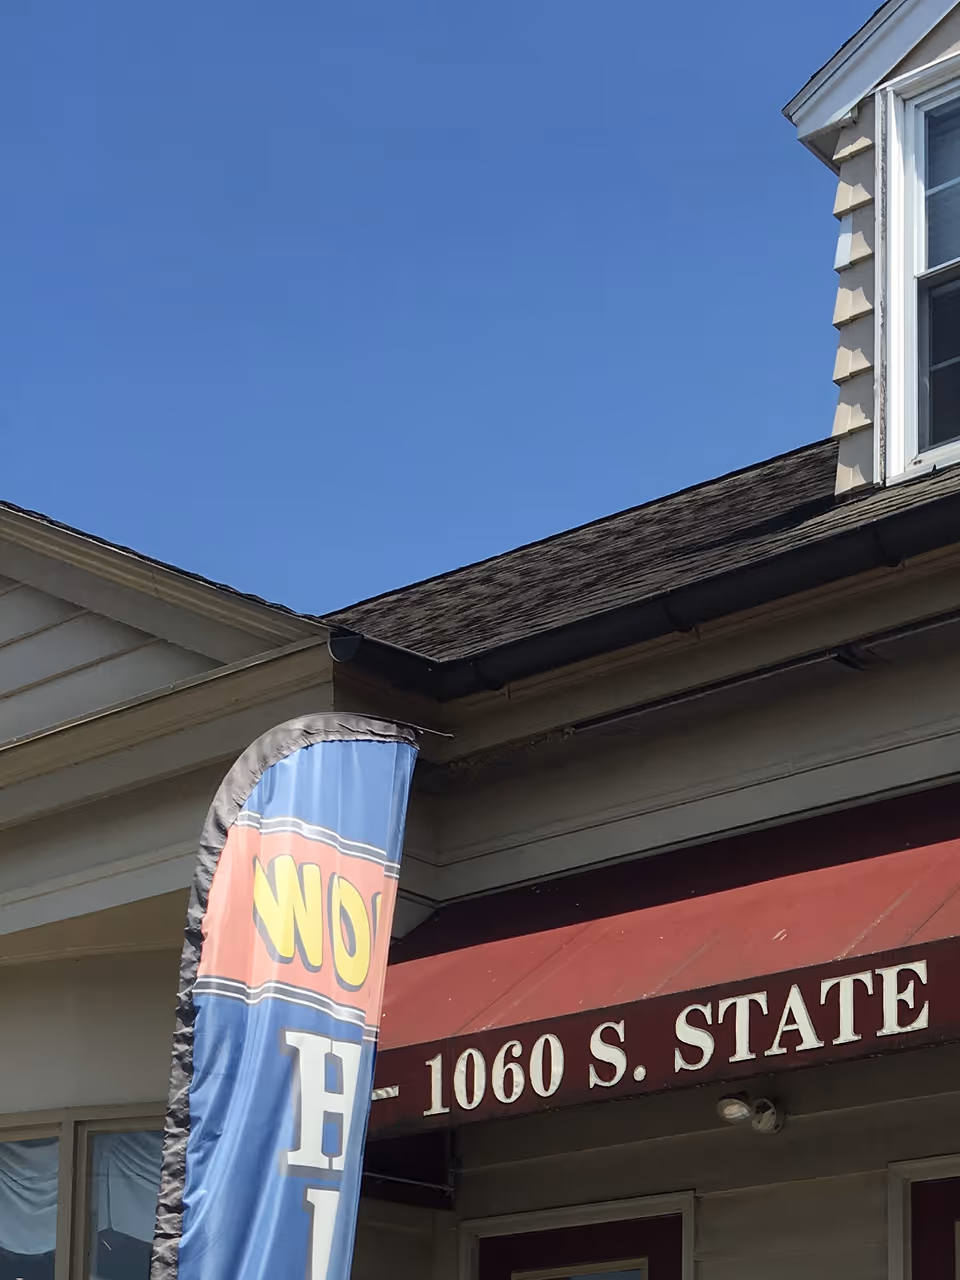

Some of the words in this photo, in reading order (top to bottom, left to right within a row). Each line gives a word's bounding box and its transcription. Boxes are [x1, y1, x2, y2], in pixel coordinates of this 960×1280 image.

[423, 1033, 565, 1117] 1060
[589, 1020, 647, 1089] S.
[674, 959, 929, 1074] STATE
